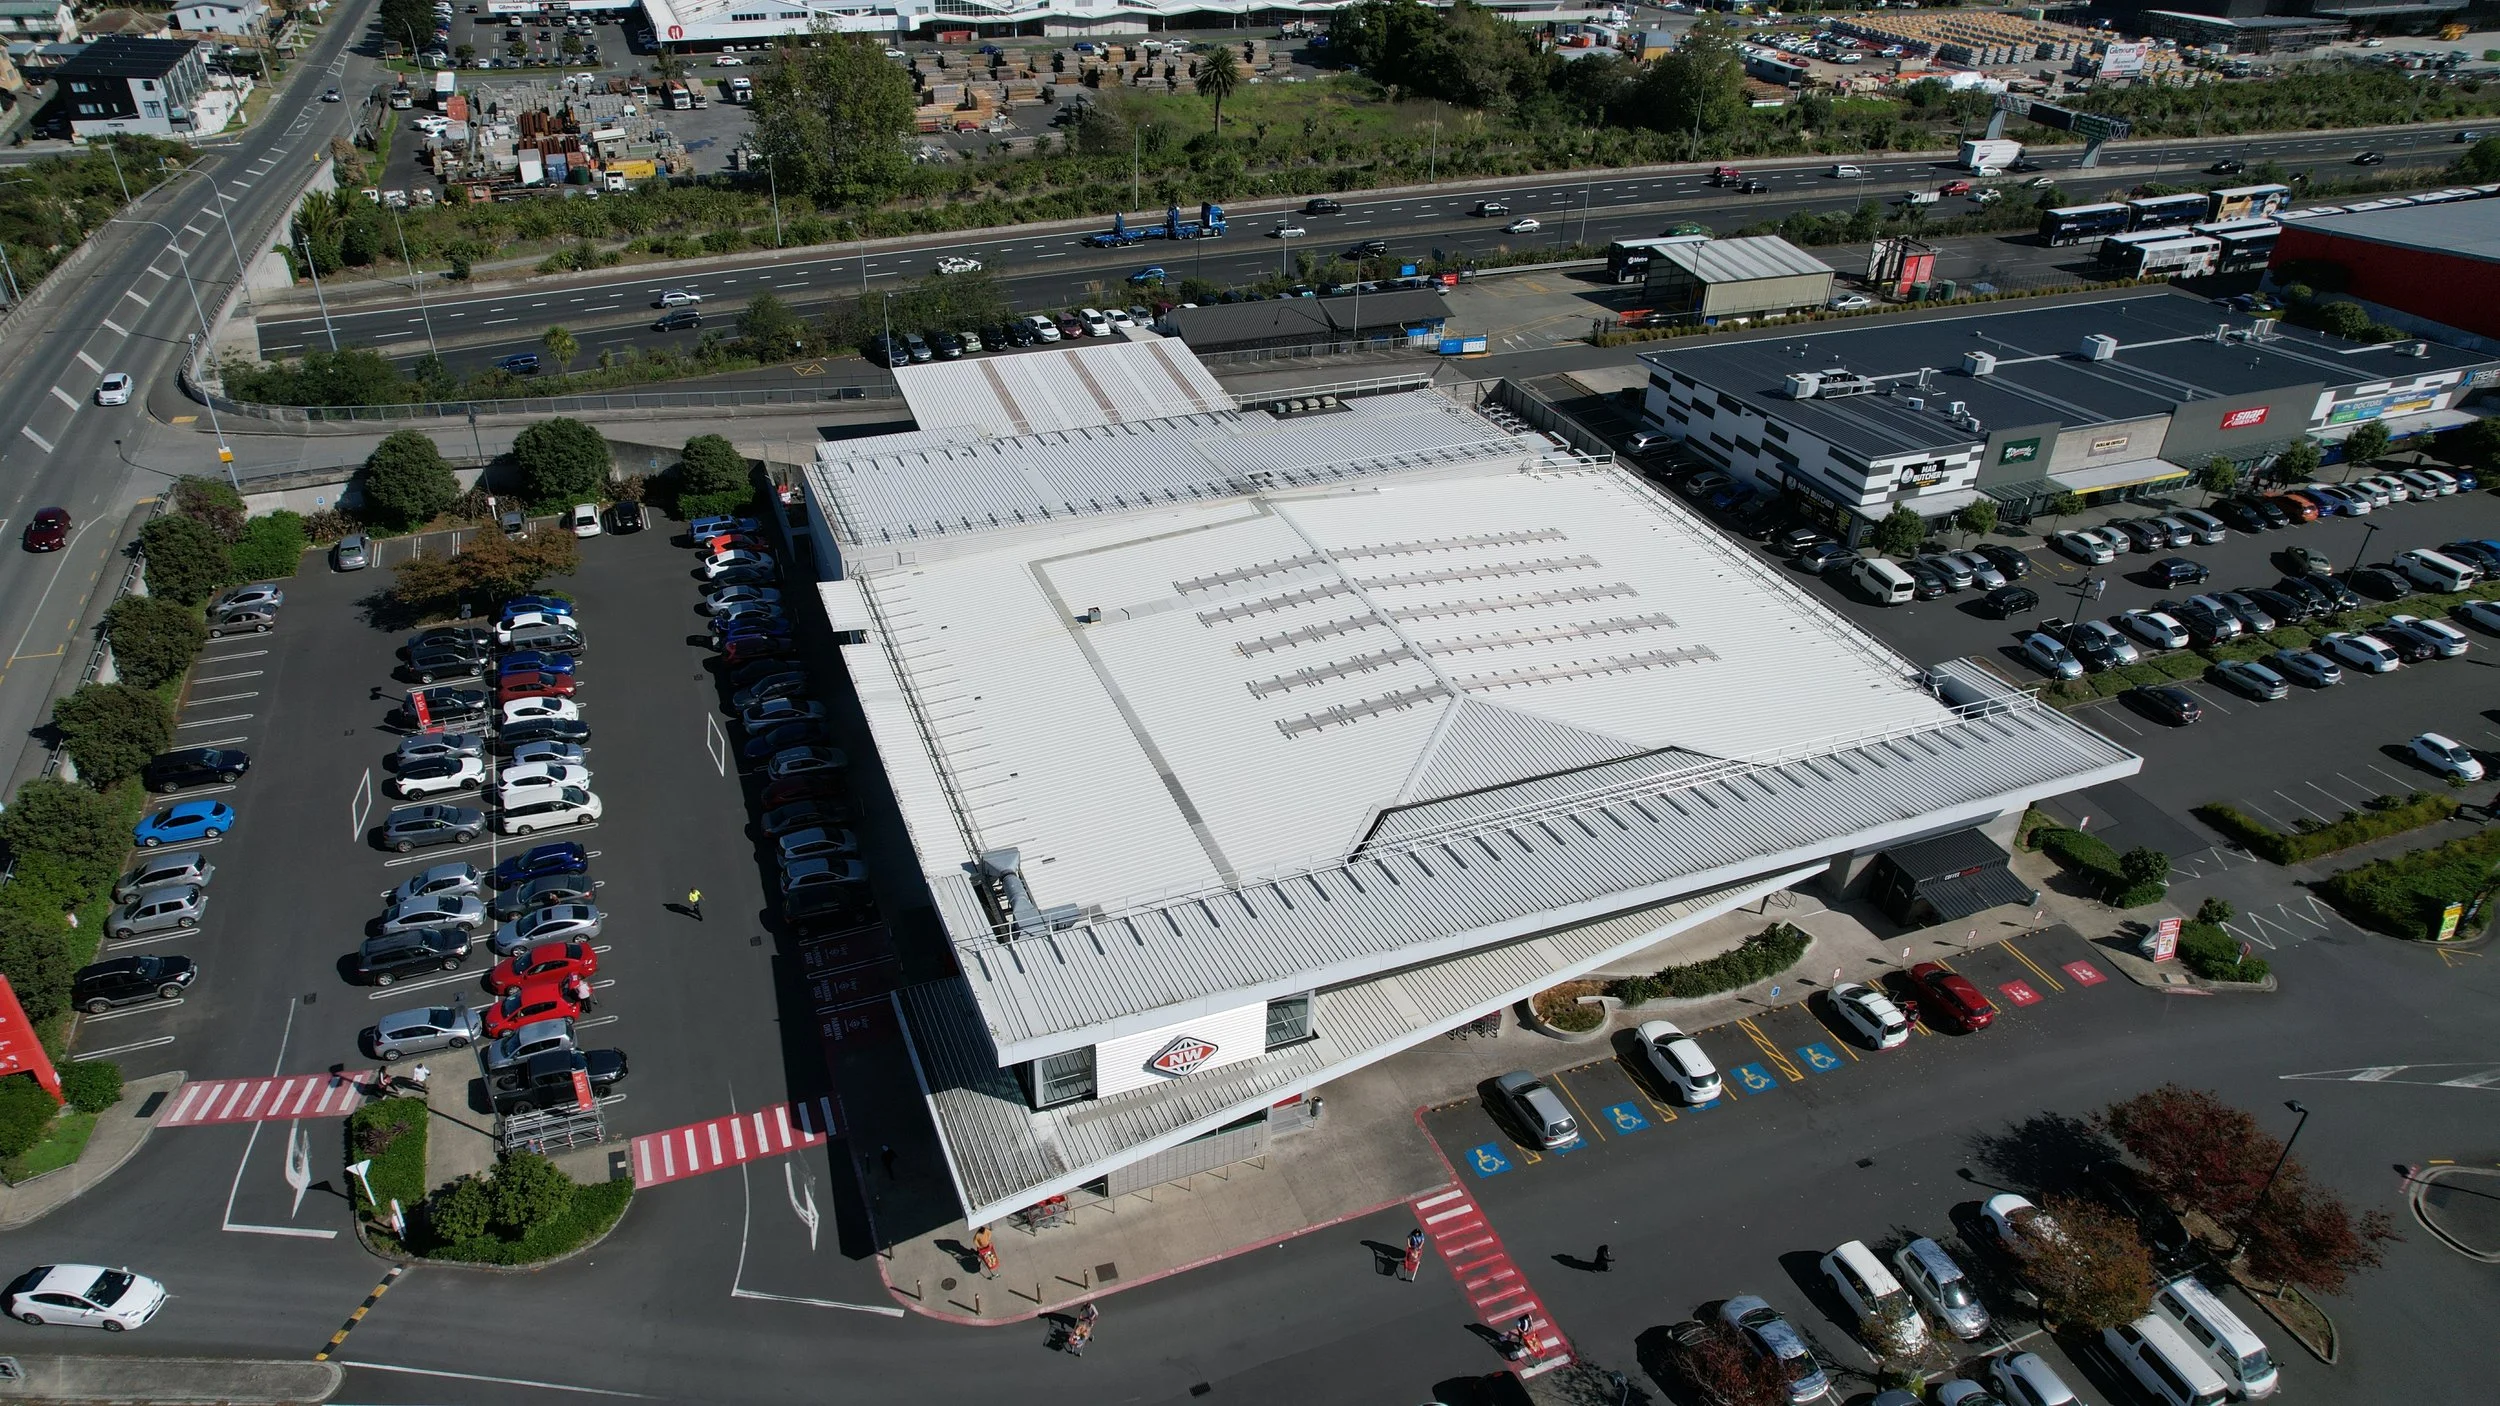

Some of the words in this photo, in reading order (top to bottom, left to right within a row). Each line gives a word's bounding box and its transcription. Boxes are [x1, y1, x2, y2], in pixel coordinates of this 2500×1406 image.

[2352, 399, 2383, 410] DOCTORS
[1921, 464, 1938, 474] MAD
[1912, 471, 1942, 483] BUTCHER
[1797, 482, 1810, 495] MAD
[1810, 489, 1835, 510] BUTCHER
[1169, 1047, 1203, 1066] NW
